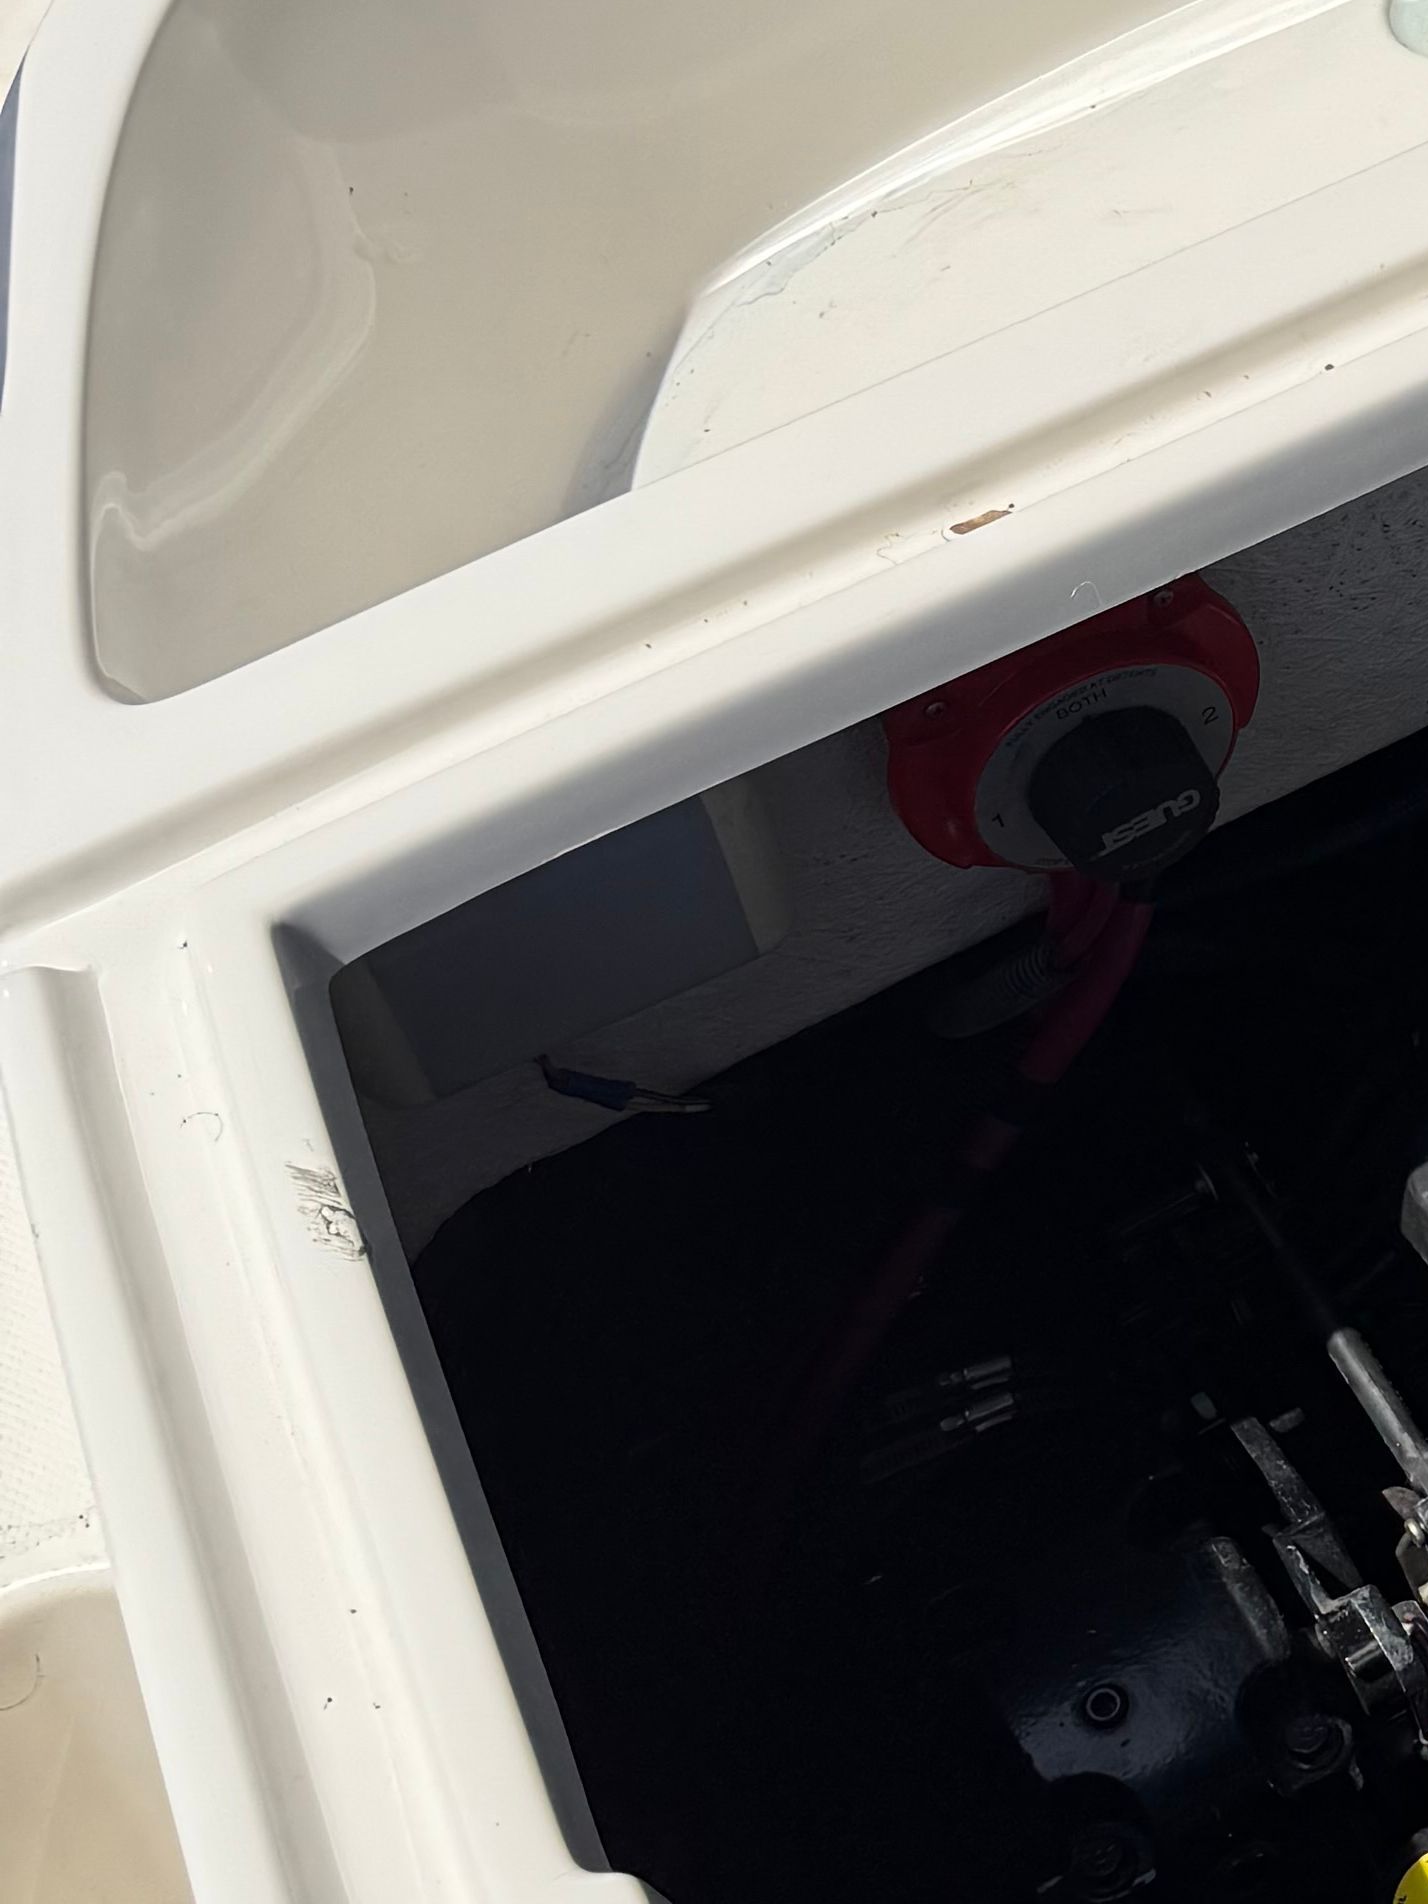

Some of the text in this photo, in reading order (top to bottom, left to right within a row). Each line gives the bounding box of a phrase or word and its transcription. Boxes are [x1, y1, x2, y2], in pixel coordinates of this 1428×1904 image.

[1056, 689, 1108, 719] BOTH
[1203, 706, 1219, 726] 2
[992, 814, 1007, 828] 1
[1090, 788, 1201, 861] GUEST
